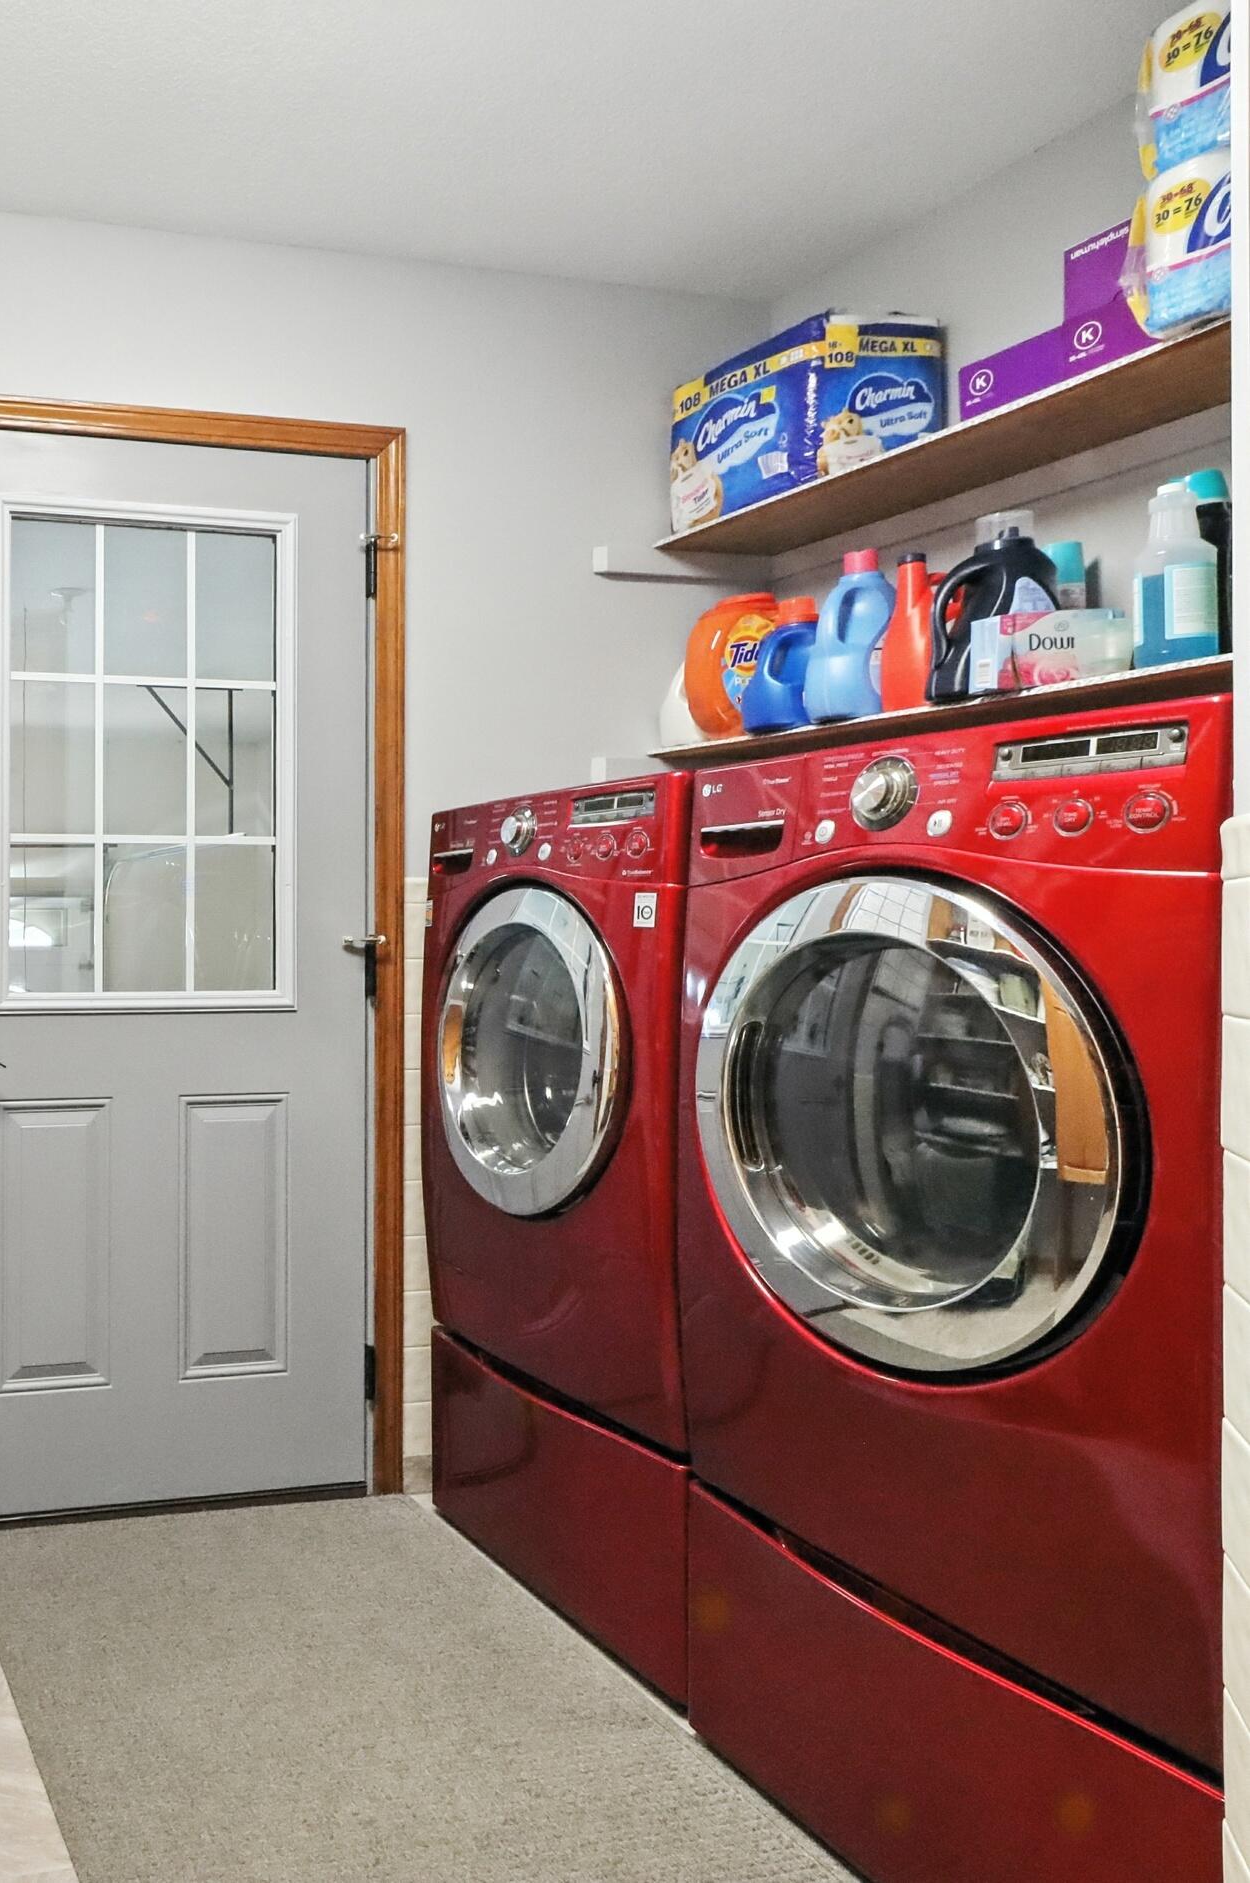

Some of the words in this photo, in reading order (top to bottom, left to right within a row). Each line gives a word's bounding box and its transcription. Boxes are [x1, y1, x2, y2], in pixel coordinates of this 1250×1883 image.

[1194, 26, 1213, 47] 76
[1155, 209, 1170, 225] 30
[1184, 193, 1203, 212] 76
[827, 351, 855, 364] 108
[859, 338, 897, 353] MEGA
[902, 341, 918, 353] XL
[679, 391, 702, 414] 108
[710, 371, 748, 397] MEGA
[754, 361, 771, 379] XL
[855, 385, 916, 411] Charmin
[696, 399, 757, 453] Charmin
[717, 441, 743, 464] Ultra
[743, 427, 769, 443] Soft
